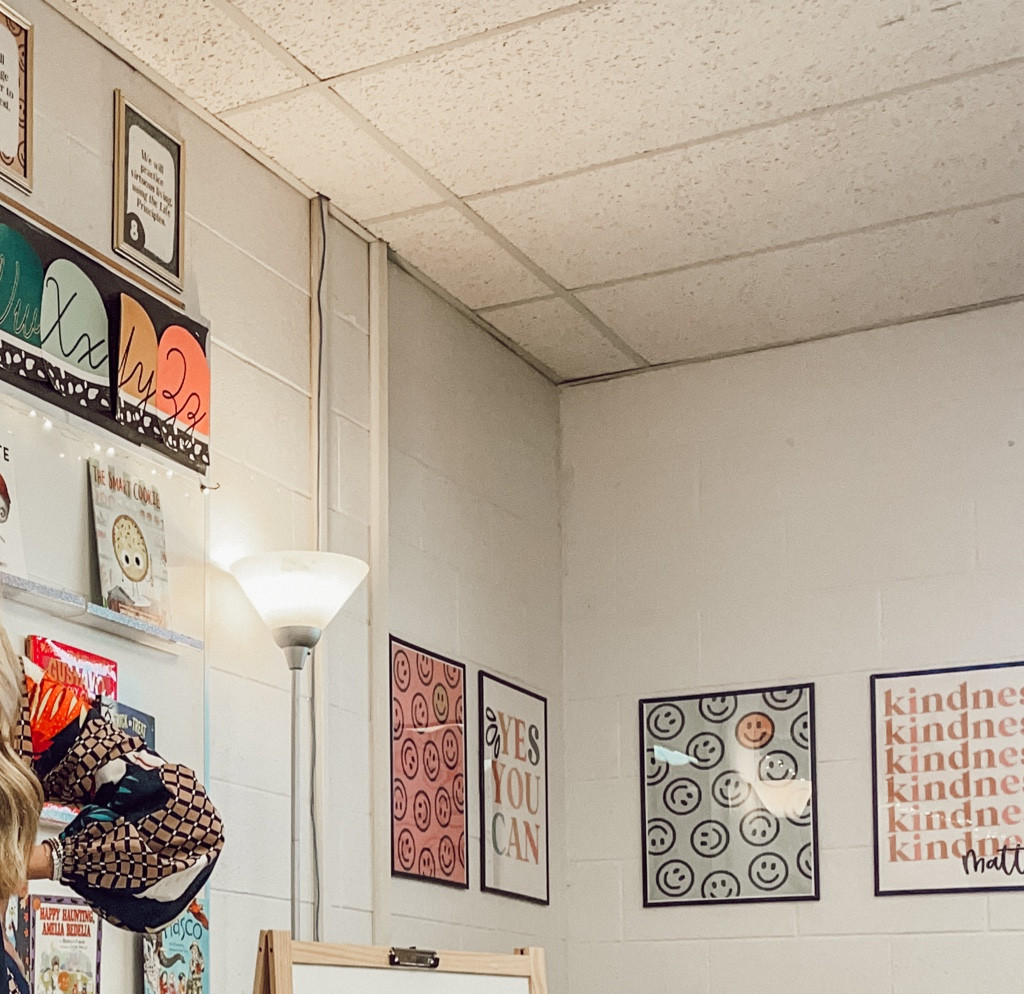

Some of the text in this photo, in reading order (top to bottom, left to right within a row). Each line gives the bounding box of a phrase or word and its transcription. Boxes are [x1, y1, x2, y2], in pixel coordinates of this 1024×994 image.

[6, 87, 14, 99] to
[129, 218, 139, 241] 8
[40, 277, 109, 369] Xx
[162, 347, 207, 437] Zz
[496, 709, 541, 767] YES
[884, 710, 1024, 746] kindne
[884, 740, 1024, 775] kindne
[490, 757, 541, 816] YOU
[887, 769, 1024, 804] kindne
[491, 811, 540, 866] CAN
[39, 906, 60, 921] HAPPY
[42, 921, 91, 938] AMELIA BEDELIA
